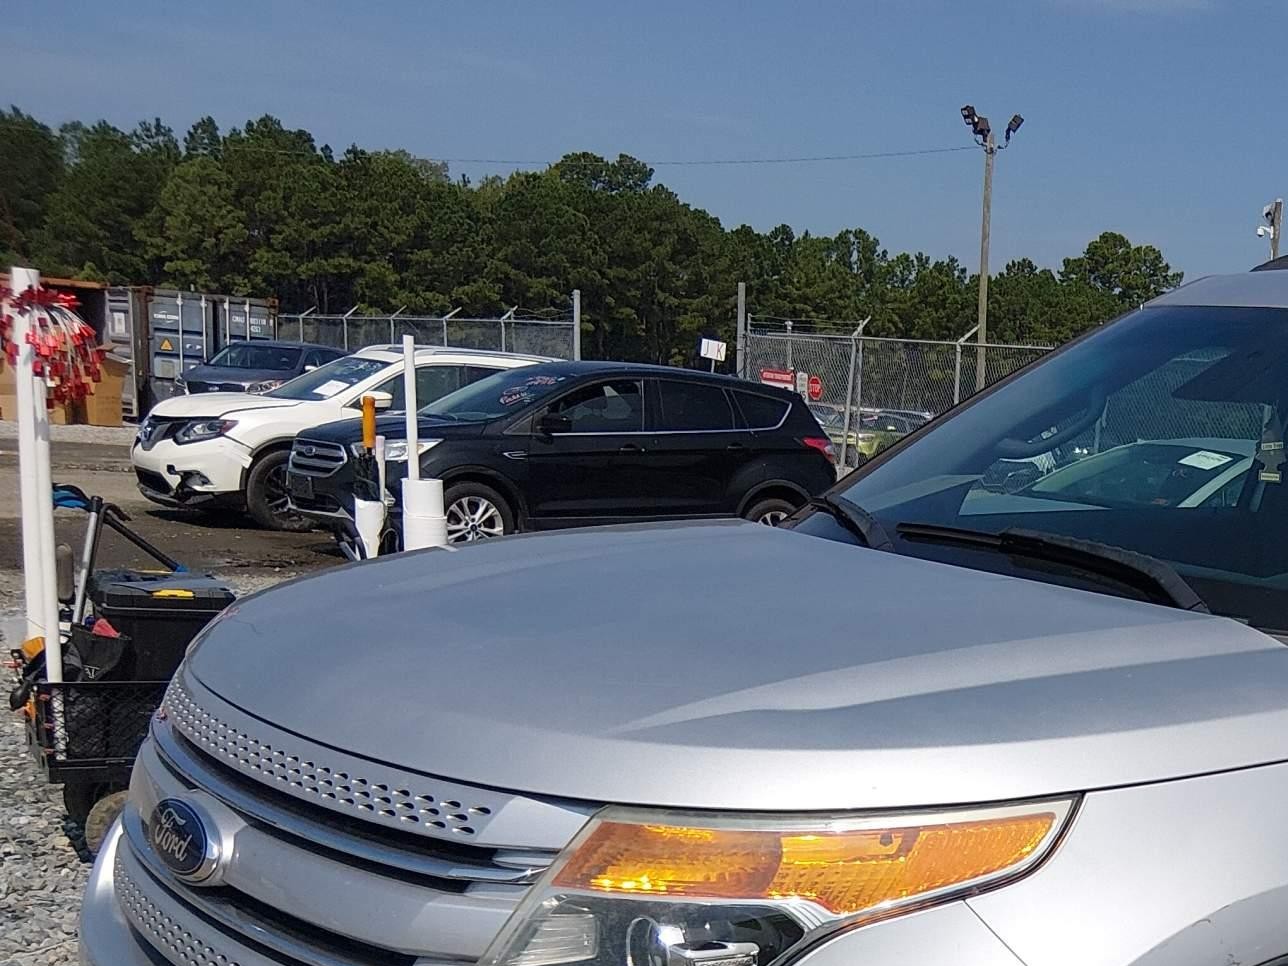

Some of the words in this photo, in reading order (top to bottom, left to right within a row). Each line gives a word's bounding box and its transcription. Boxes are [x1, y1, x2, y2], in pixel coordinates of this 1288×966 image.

[717, 343, 724, 360] K
[809, 383, 821, 393] STOP
[154, 807, 193, 862] Ford
